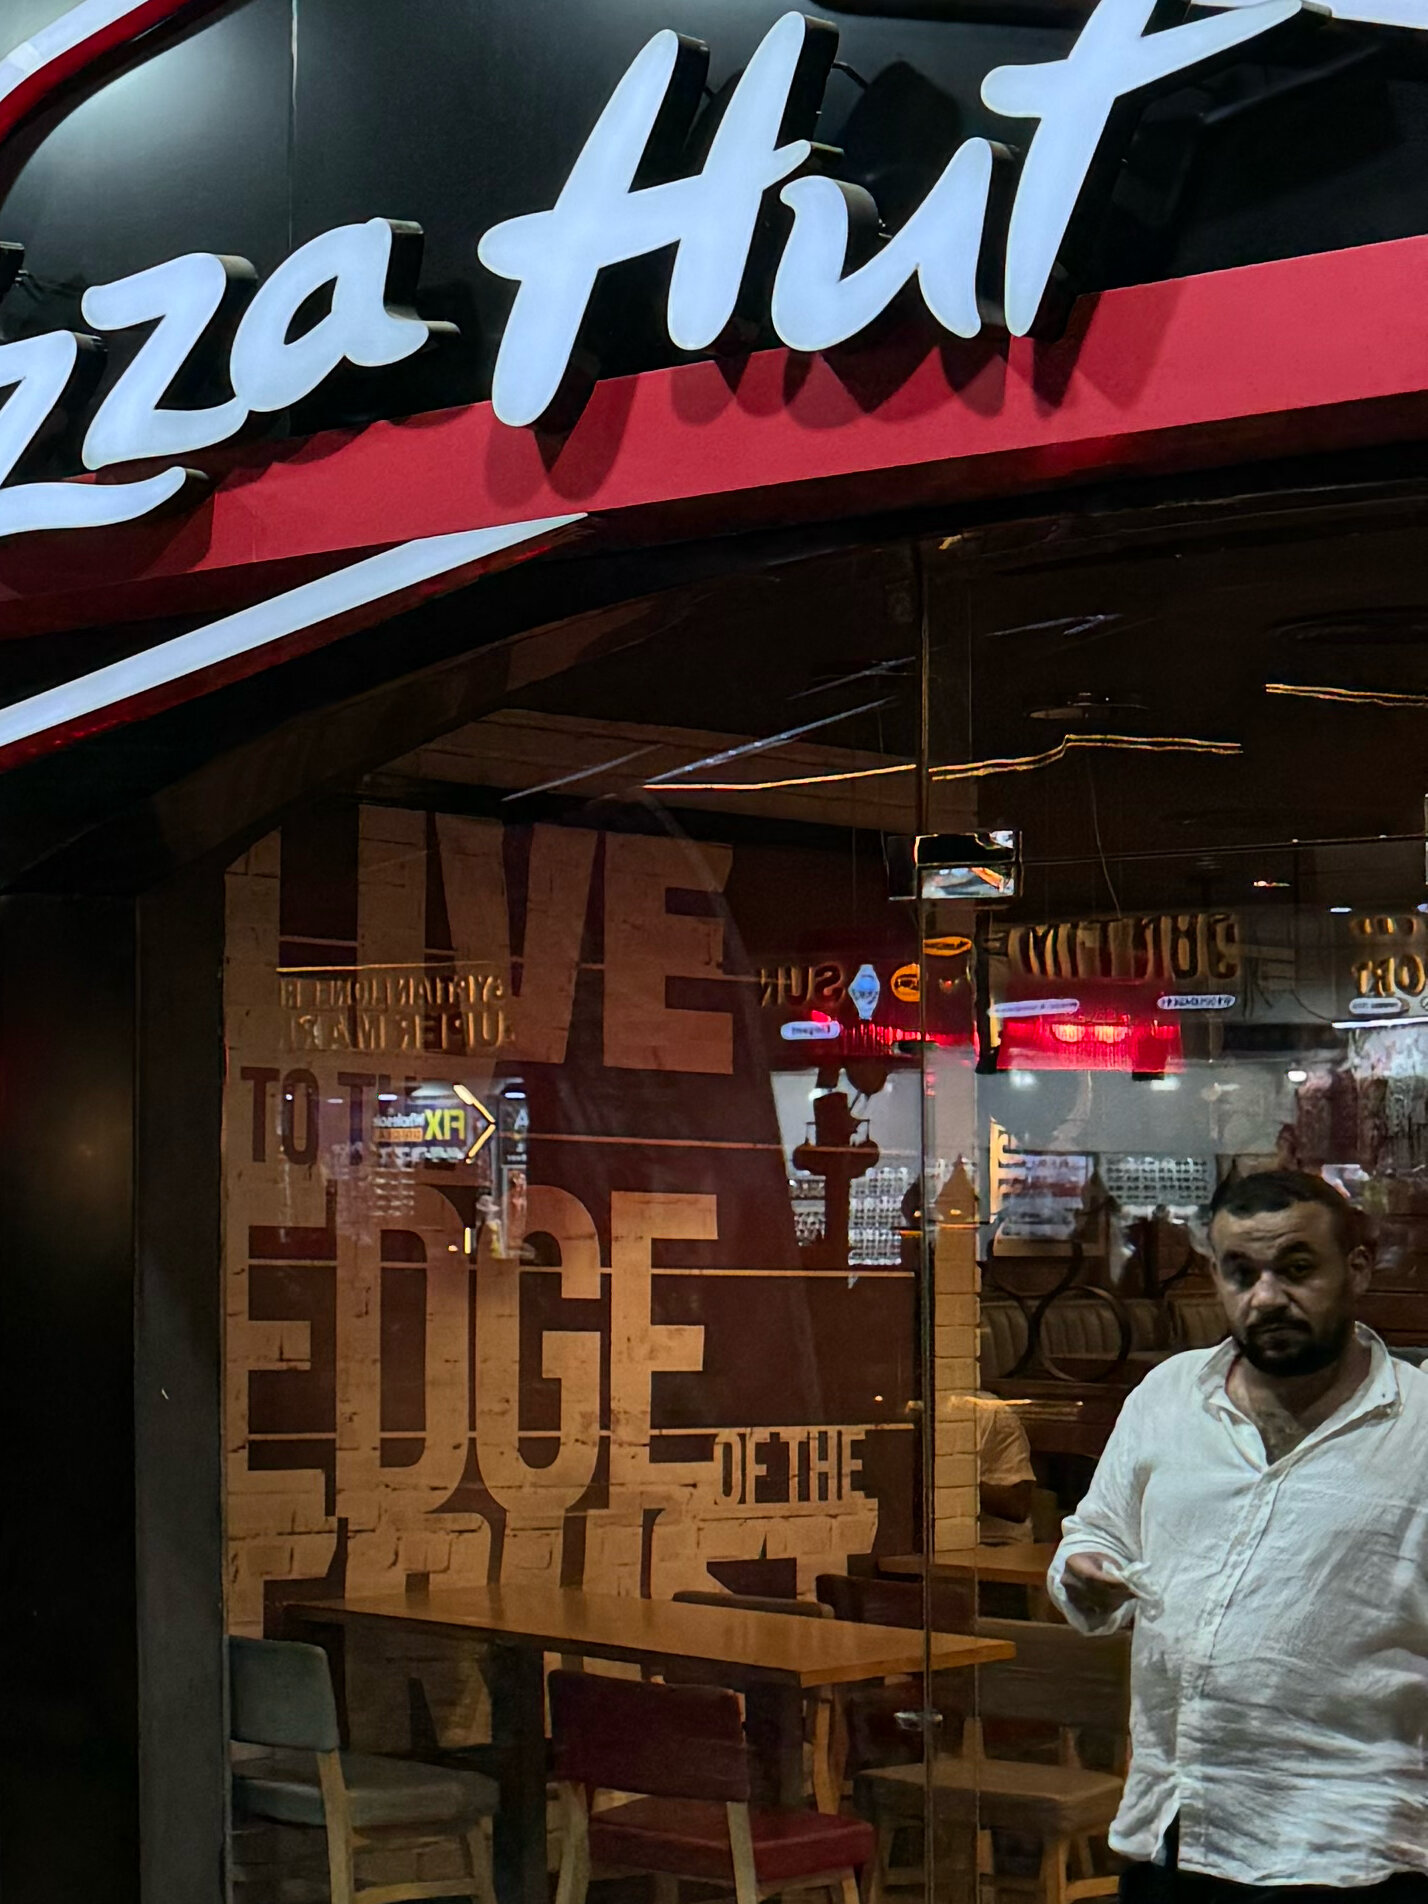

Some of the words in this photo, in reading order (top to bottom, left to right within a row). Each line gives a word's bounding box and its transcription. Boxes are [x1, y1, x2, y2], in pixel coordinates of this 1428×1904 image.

[225, 804, 734, 1074] LIVE
[240, 1065, 320, 1165] TO
[226, 1180, 719, 1515] EDGE
[713, 1429, 769, 1506] OF
[787, 1428, 868, 1503] THE
